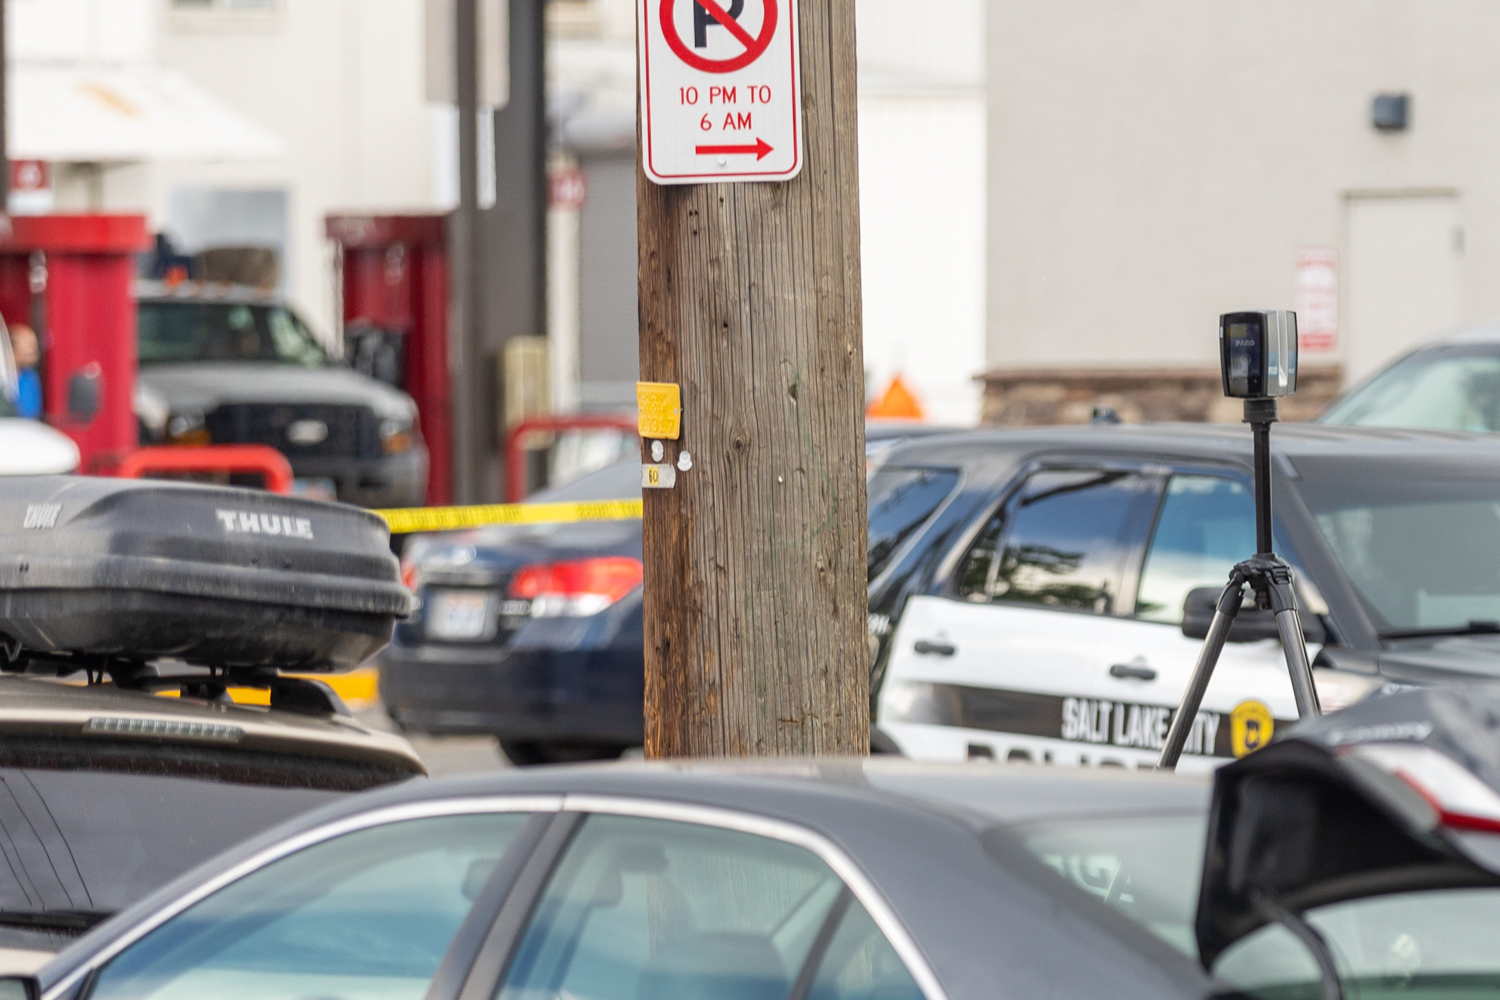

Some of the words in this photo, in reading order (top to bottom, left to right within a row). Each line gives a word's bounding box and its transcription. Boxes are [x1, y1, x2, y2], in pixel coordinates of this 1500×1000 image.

[680, 86, 699, 105] 10
[709, 86, 737, 104] PM
[747, 85, 772, 104] TO
[700, 113, 712, 131] 6
[723, 112, 752, 130] AM
[216, 508, 313, 540] THULE
[1061, 698, 1113, 743] SALT
[1113, 702, 1170, 751] LAKE
